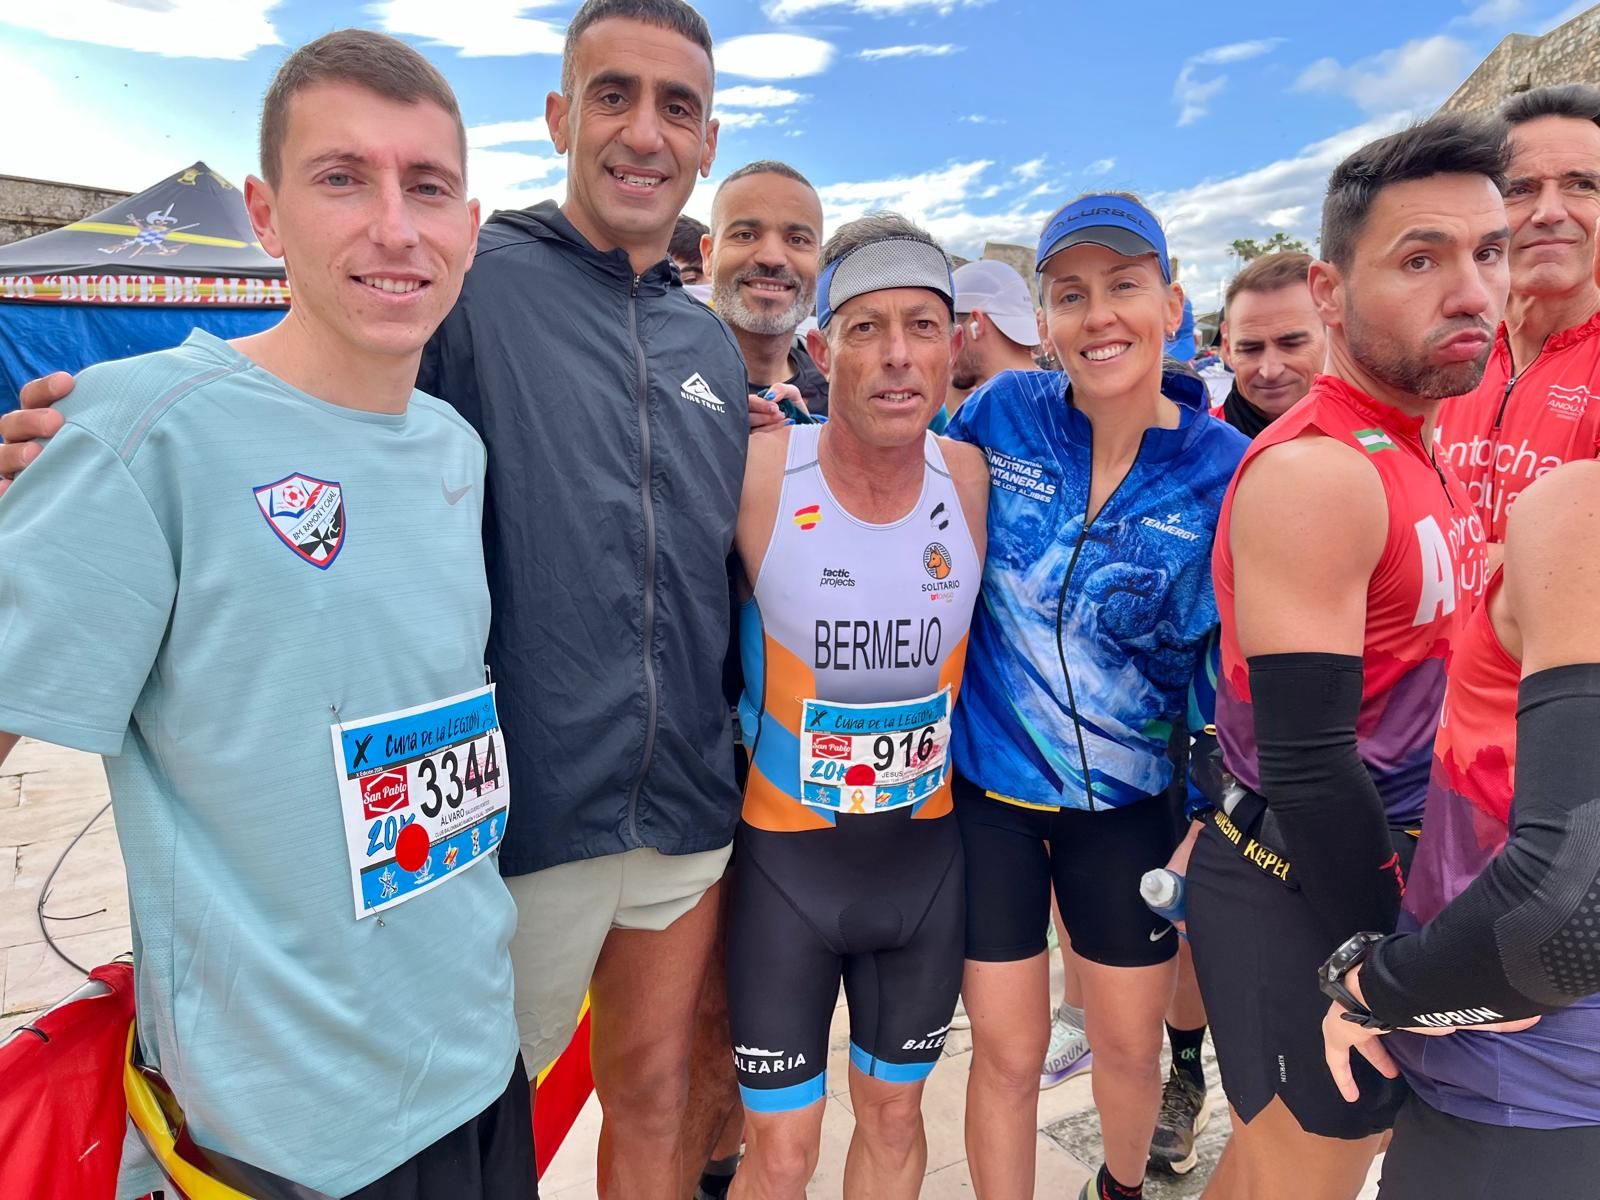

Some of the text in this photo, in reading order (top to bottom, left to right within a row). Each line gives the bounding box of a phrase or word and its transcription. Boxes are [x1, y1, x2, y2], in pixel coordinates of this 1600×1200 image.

[163, 277, 201, 303] DE
[701, 399, 726, 413] TRAIL
[991, 455, 1043, 479] NUTRIAS
[1002, 482, 1017, 492] LOS
[1018, 488, 1052, 503] ALJIBES
[819, 576, 856, 588] projects
[823, 567, 850, 578] tactic
[921, 579, 960, 592] SOLITARIO
[814, 616, 942, 671] BERMEJO
[811, 709, 828, 728] X
[353, 733, 374, 769] X
[828, 744, 851, 753] Pablo
[873, 726, 935, 771] 916
[417, 735, 501, 819] 3344
[363, 782, 408, 806] San Pablo
[1412, 1006, 1504, 1027] KIPRUN
[901, 1036, 945, 1050] BALE
